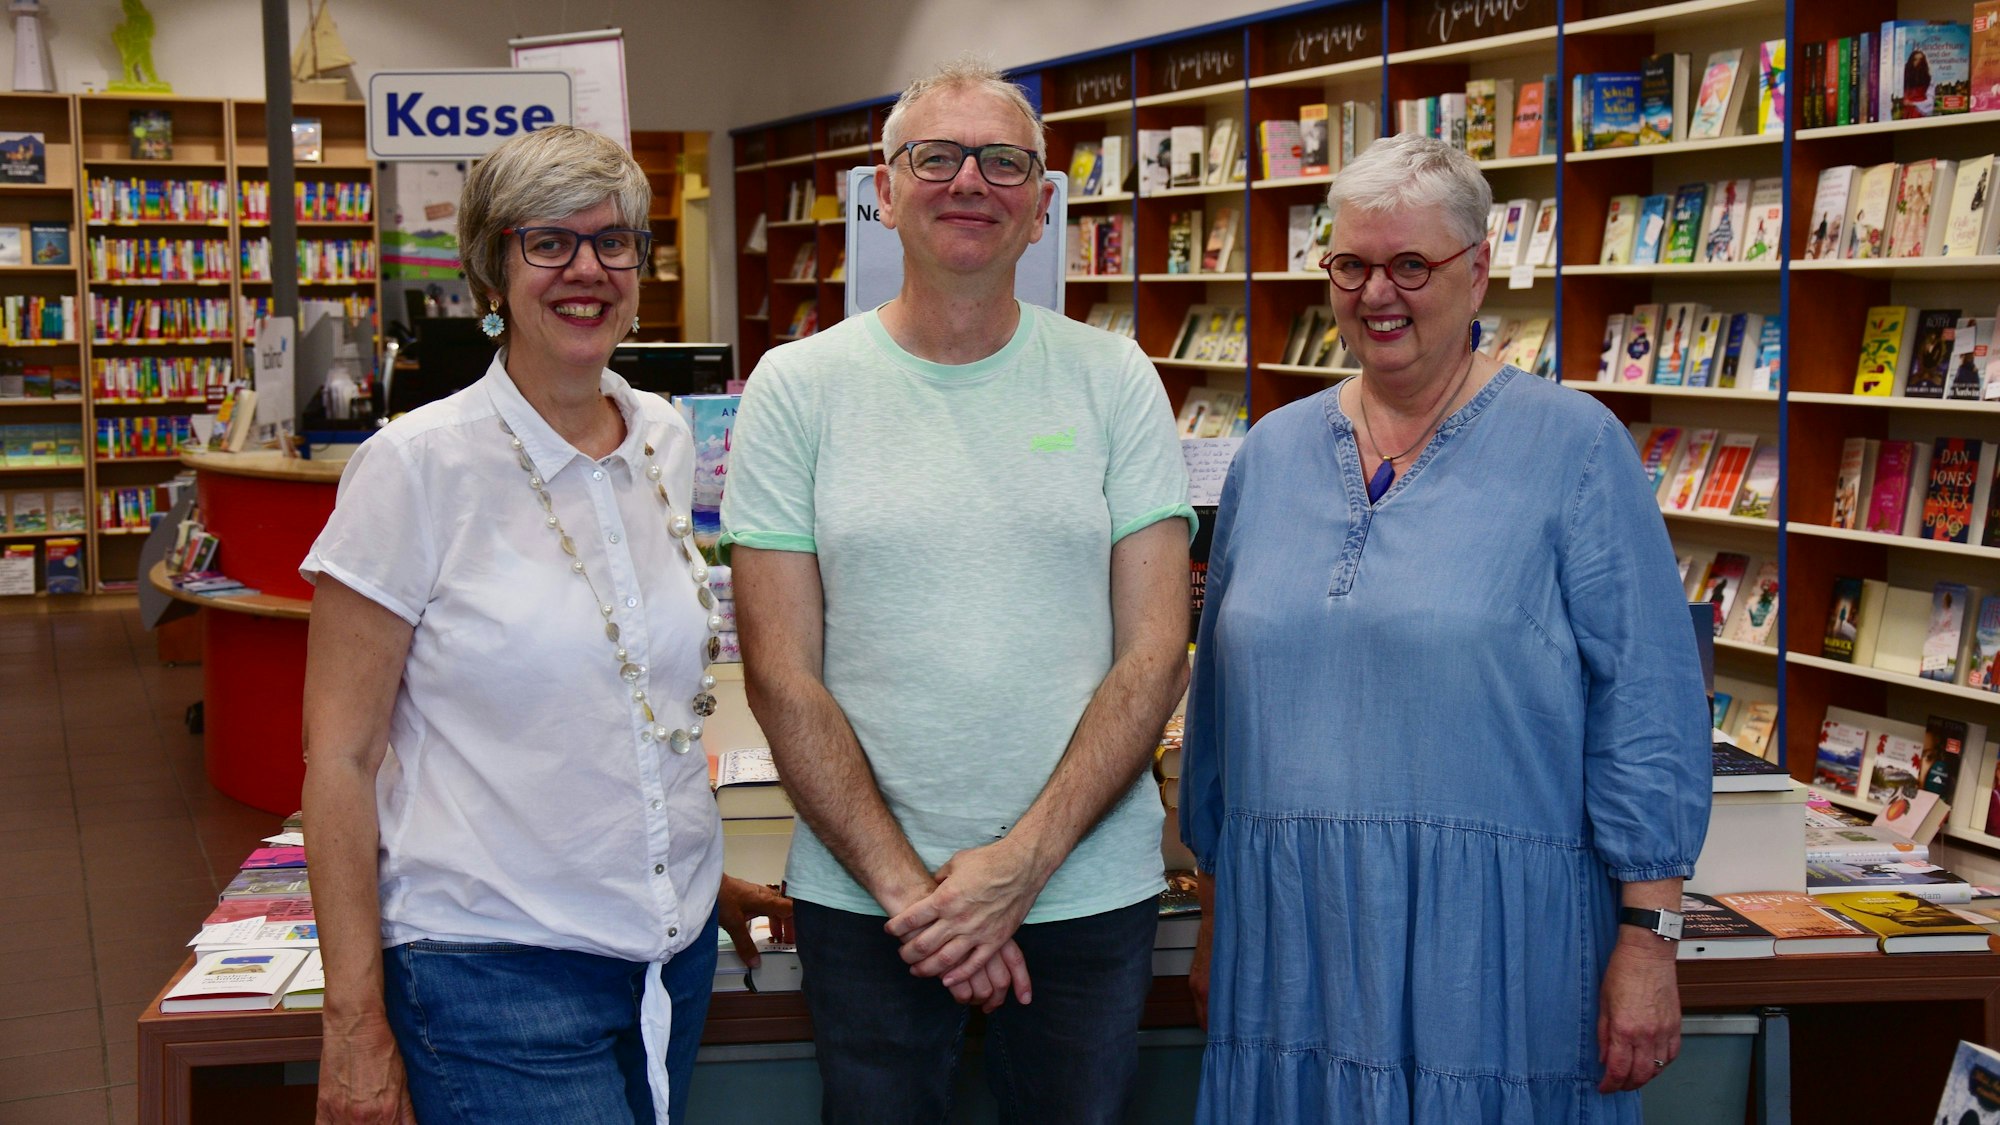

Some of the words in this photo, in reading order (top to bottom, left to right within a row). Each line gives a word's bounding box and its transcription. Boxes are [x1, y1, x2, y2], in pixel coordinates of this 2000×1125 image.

[386, 92, 556, 137] Kasse
[1940, 448, 1970, 465] DAN
[1931, 470, 1973, 487] JONES
[1927, 490, 1970, 510] ESSEX
[1723, 895, 1815, 906] Bayer
